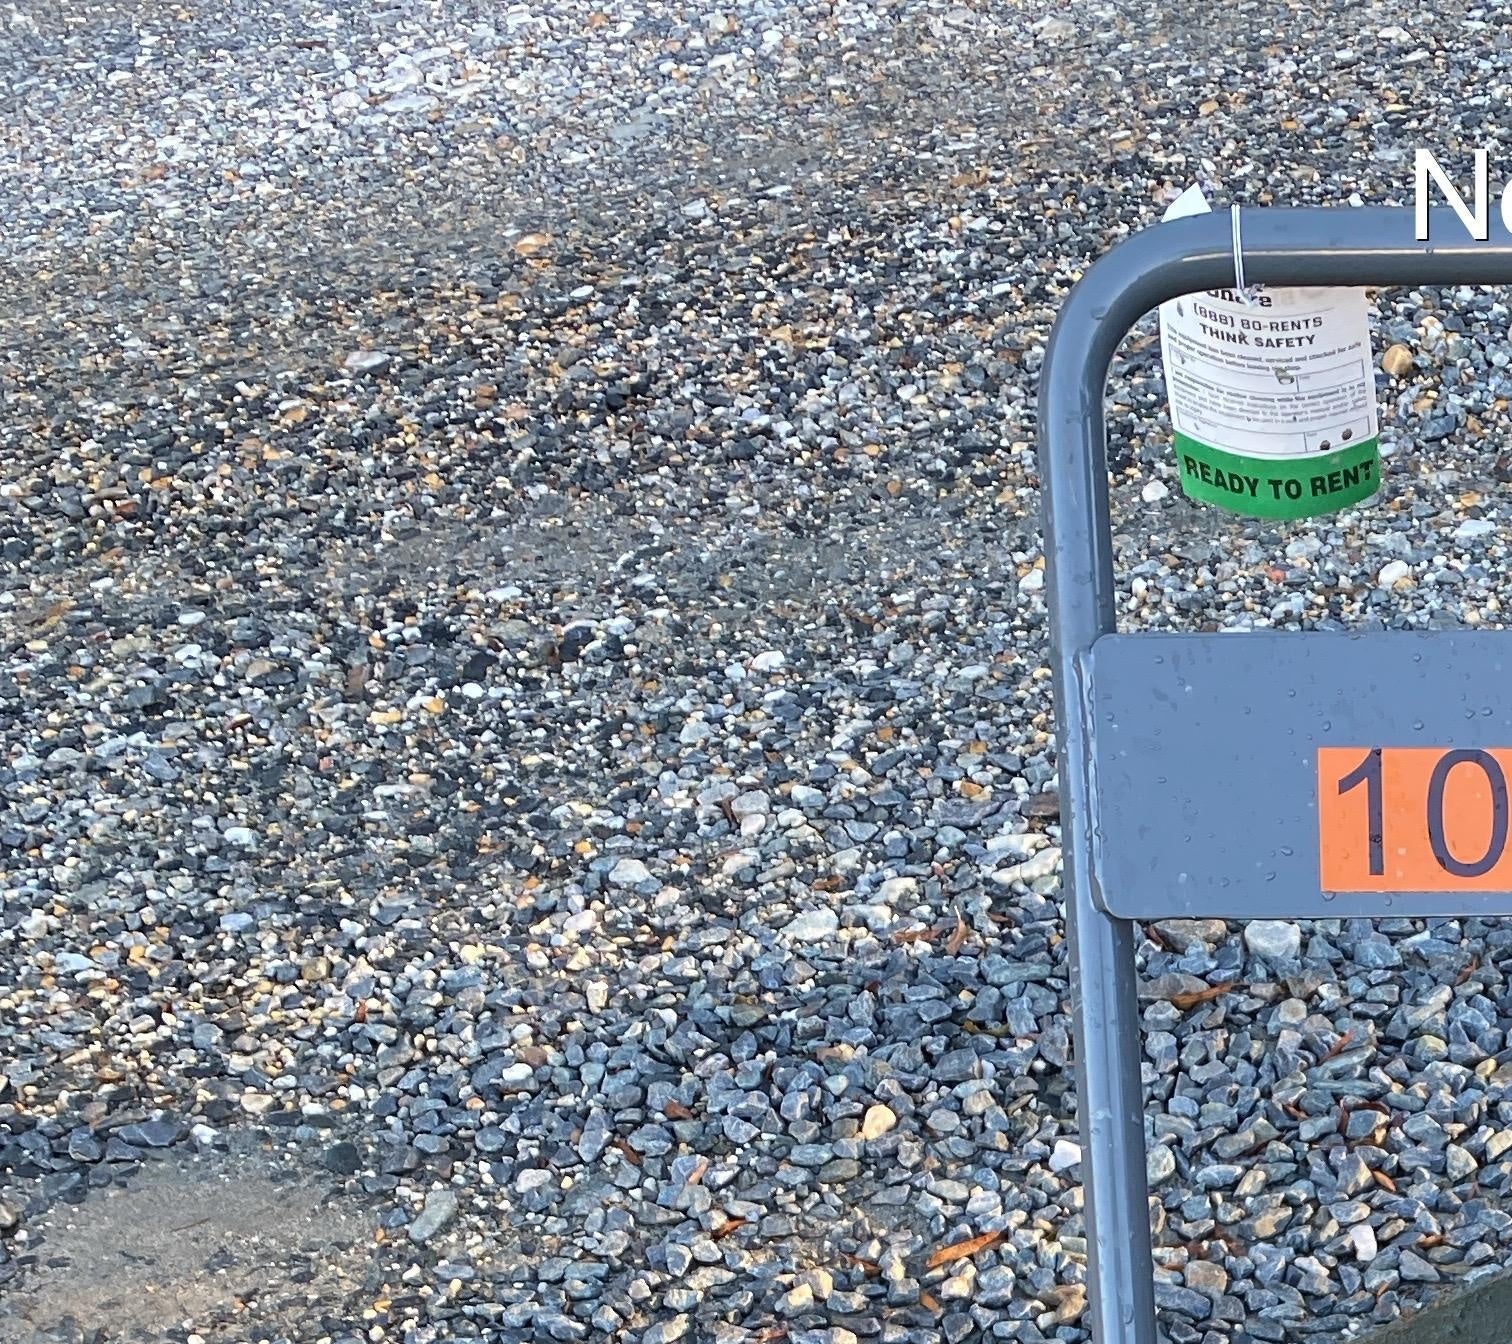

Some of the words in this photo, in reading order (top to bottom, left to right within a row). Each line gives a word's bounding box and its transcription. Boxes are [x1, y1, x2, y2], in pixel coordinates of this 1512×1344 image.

[1193, 302, 1235, 328] (888)
[1240, 316, 1323, 332] 80-RENTS
[1199, 322, 1250, 346] THINK
[1254, 334, 1316, 348] SAFETY
[1183, 453, 1260, 499] READY
[1267, 477, 1302, 501] TO
[1310, 457, 1375, 499] RENT
